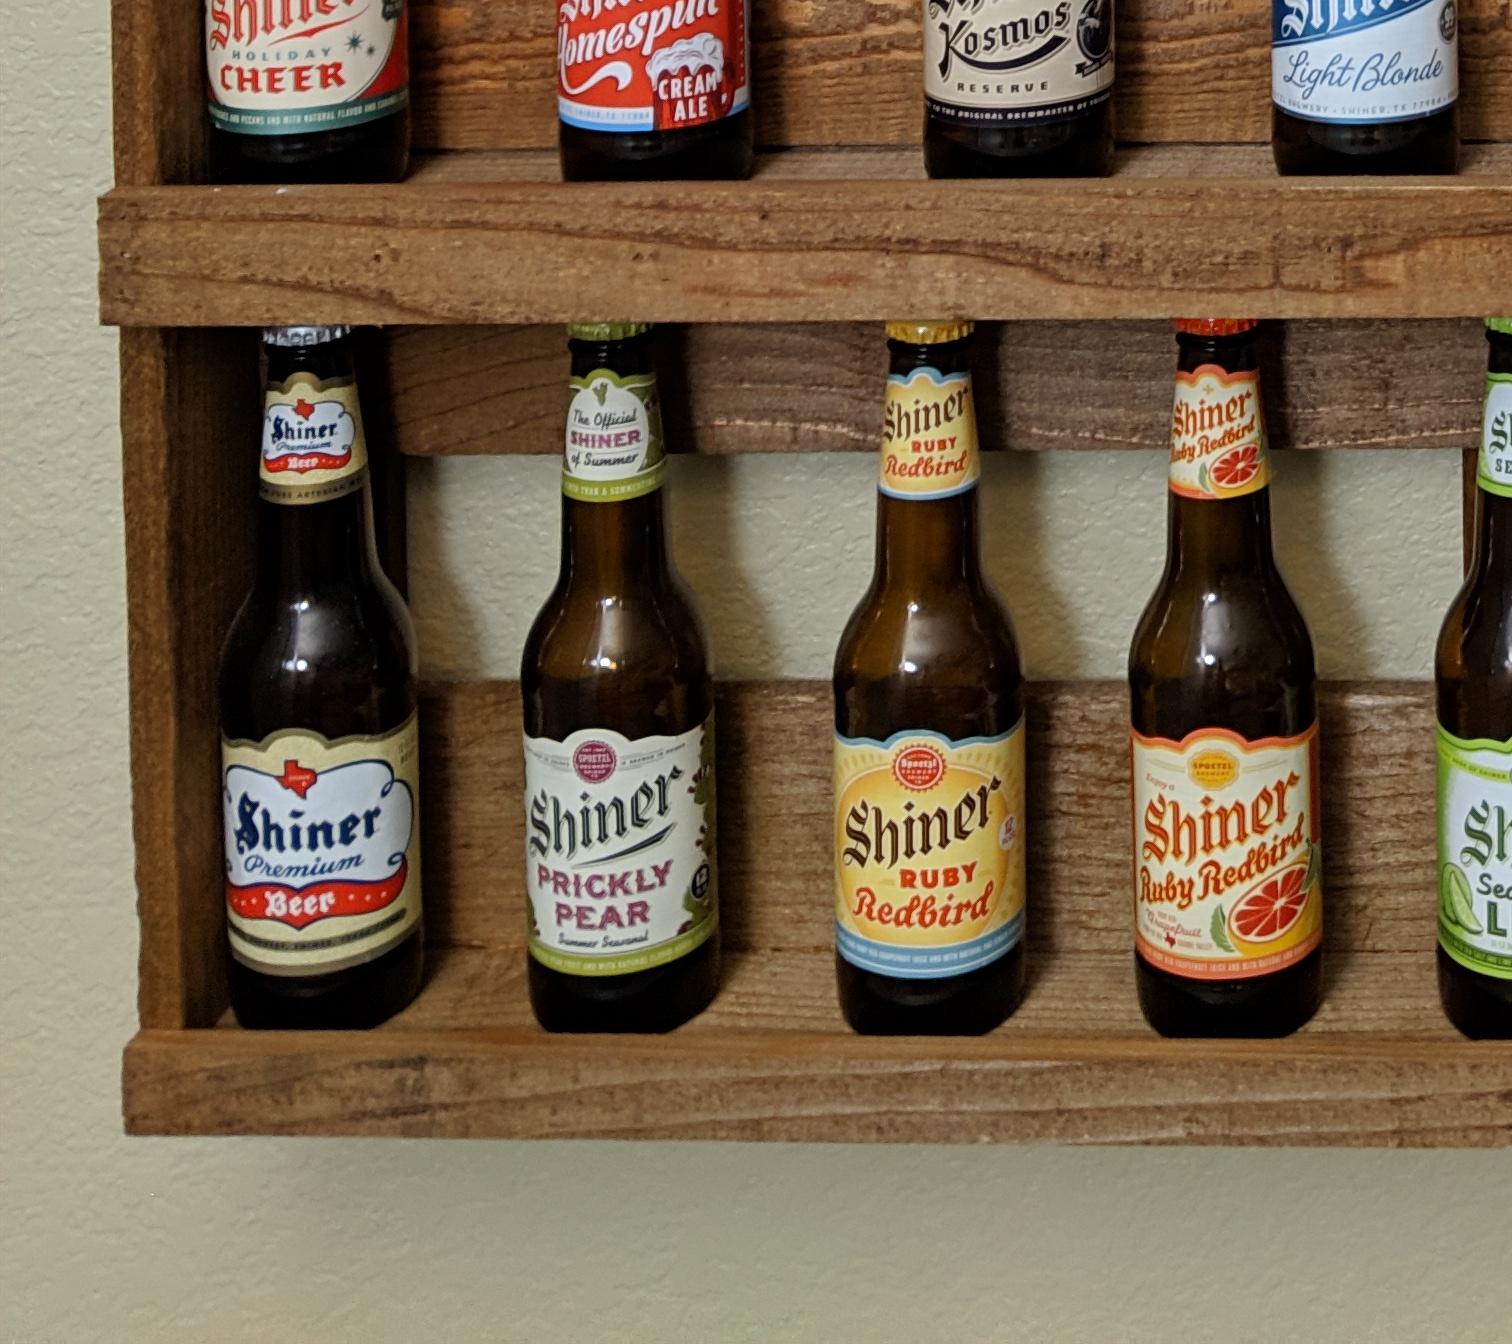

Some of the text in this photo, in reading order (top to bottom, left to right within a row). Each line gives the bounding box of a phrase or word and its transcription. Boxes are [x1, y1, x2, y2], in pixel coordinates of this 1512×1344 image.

[233, 48, 331, 61] HOLIDAY
[938, 2, 1072, 82] Kosmos
[221, 62, 346, 93] CHEER
[659, 70, 717, 100] CREAM
[958, 81, 1048, 93] RESERVE
[1283, 49, 1442, 100] Light Blonde
[674, 97, 708, 121] ALE
[574, 408, 637, 430] The Official
[571, 430, 642, 448] SHINER
[911, 437, 956, 453] RUBY
[571, 452, 639, 467] of Summer
[234, 791, 382, 854] Shiner
[530, 765, 683, 857] Shiner
[843, 776, 1001, 869] Shiner
[1142, 771, 1300, 865] Shiner
[244, 852, 365, 878] Premium
[900, 862, 977, 890] RUBY
[1140, 813, 1304, 910] Ruby Redbird
[537, 859, 673, 899] PRICKLY
[264, 890, 335, 917] Beer
[555, 900, 650, 931] PEAR
[852, 880, 994, 928] Redbird
